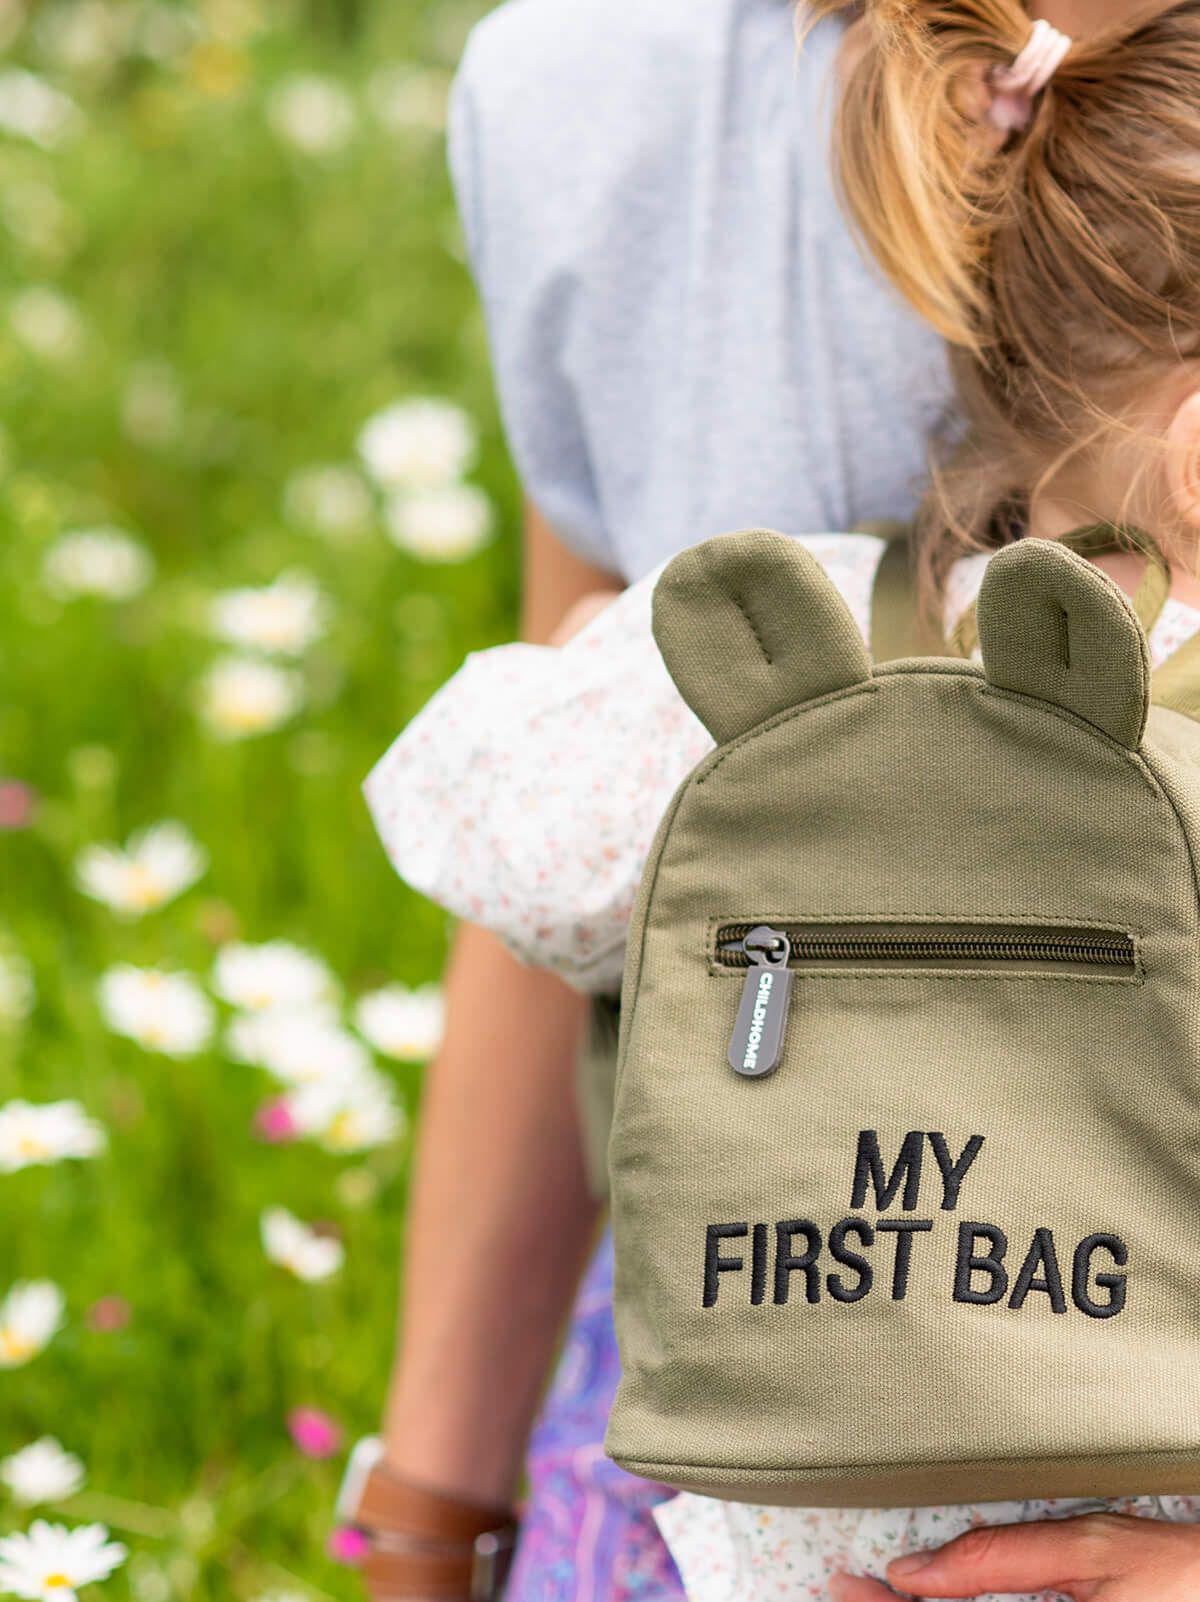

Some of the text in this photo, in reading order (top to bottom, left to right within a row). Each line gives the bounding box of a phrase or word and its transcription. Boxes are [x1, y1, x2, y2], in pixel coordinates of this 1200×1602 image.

[743, 972, 773, 1070] CHILDHOME
[850, 1130, 986, 1211] MY
[703, 1217, 1129, 1319] FIRST BAG
